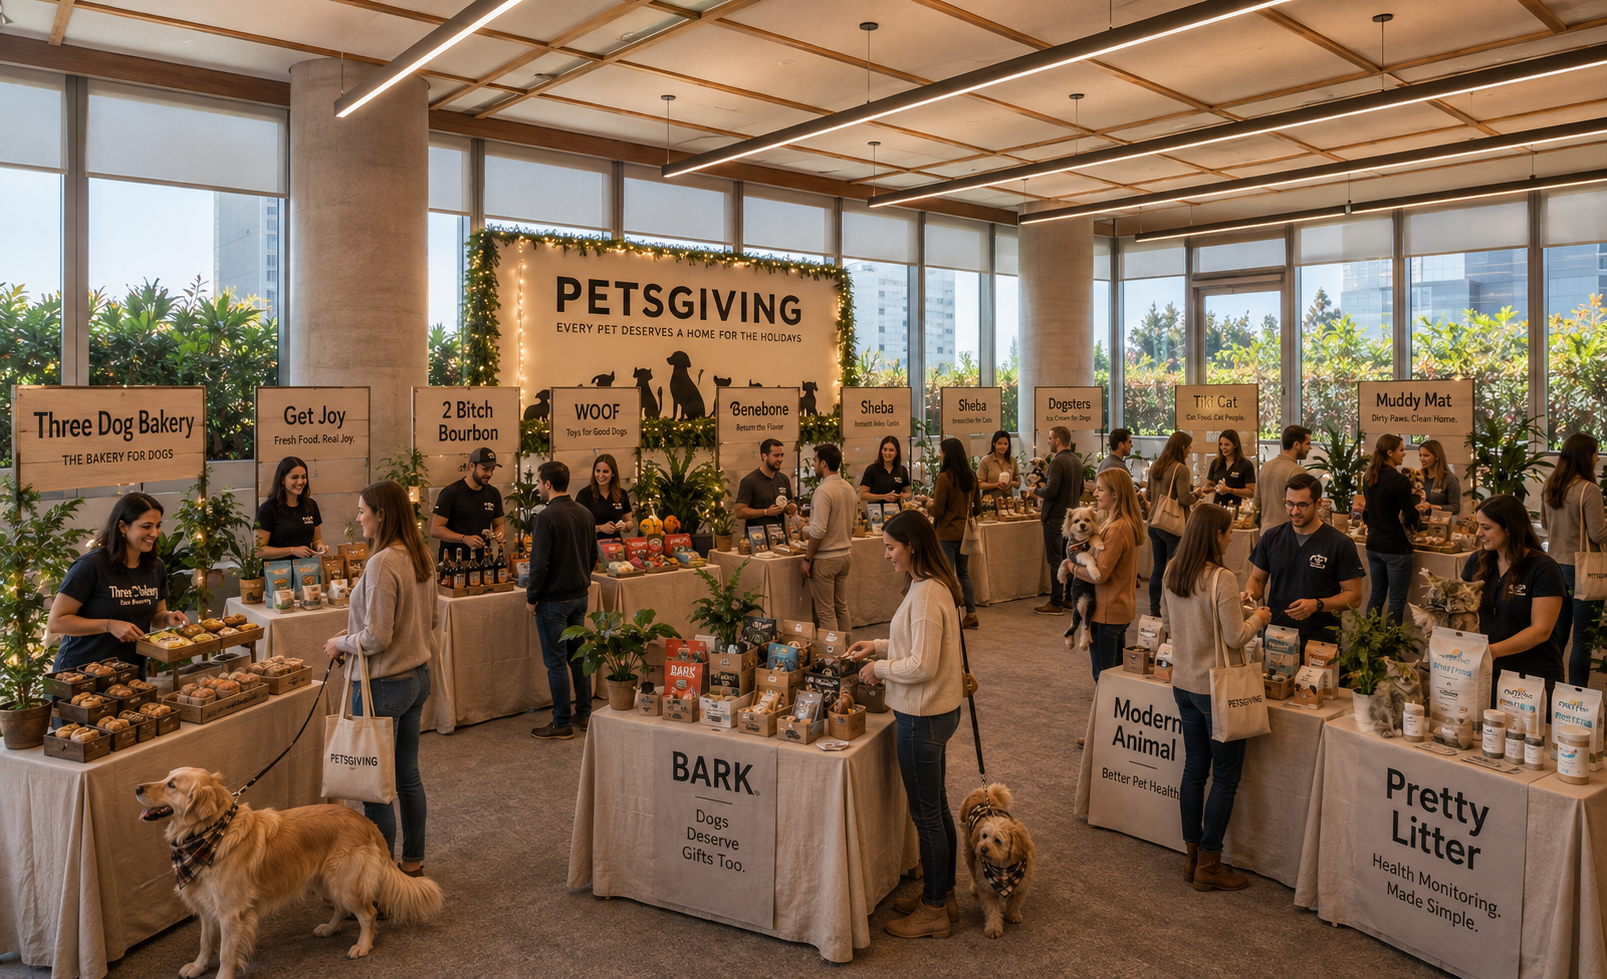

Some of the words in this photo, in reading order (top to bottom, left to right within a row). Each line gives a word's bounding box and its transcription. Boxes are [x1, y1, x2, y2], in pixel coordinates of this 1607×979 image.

[556, 276, 802, 325] PETSGIVING
[556, 322, 594, 334] EVERY
[597, 324, 618, 335] PET
[621, 325, 674, 337] DESERVES
[676, 328, 684, 338] A
[687, 329, 715, 339] HOME
[719, 330, 738, 340] FOR
[740, 331, 758, 341] THE
[760, 332, 802, 343] HOLIDAYS
[442, 400, 452, 418] 2
[457, 400, 493, 418] Bitch
[574, 403, 620, 420] WOOF
[730, 401, 789, 416] Benebone
[861, 400, 894, 414] Sheba
[959, 398, 987, 412] Sheba
[1049, 397, 1091, 413] Dogsters
[1193, 395, 1213, 408] Tiki
[1217, 395, 1238, 408] Cat
[1376, 392, 1421, 411] Muddy
[1425, 392, 1452, 407] Mat
[33, 411, 92, 439] Three
[98, 410, 134, 442] Dog
[139, 409, 195, 438] Bakery
[284, 405, 314, 425] Get
[318, 405, 346, 429] Joy
[1371, 414, 1388, 424] Dirty
[1411, 414, 1431, 422] Clean
[1433, 415, 1458, 423] Home.
[274, 435, 297, 445] Fresh
[299, 434, 320, 444] Food.
[323, 434, 339, 443] Real
[341, 434, 355, 445] Joy.
[439, 424, 498, 442] Bourbon
[566, 428, 581, 438] Toys
[583, 428, 591, 436] for
[593, 427, 610, 436] Good
[612, 427, 627, 437] Dogs
[62, 454, 83, 466] THE
[86, 452, 124, 464] BAKERY
[127, 451, 145, 461] FOR
[149, 449, 174, 460] DOGS
[1114, 697, 1182, 734] Modern
[1112, 725, 1176, 761] Animal
[331, 753, 378, 766] PETSGIVING
[1102, 767, 1130, 785] Better
[1133, 776, 1147, 789] Pet
[1387, 767, 1489, 837] Pretty
[696, 809, 728, 830] Dogs
[687, 827, 739, 850] Deserve
[1393, 810, 1481, 870] Litter
[682, 846, 713, 865] Gifts
[718, 853, 746, 873] Too.
[1373, 853, 1414, 882] Health
[1419, 871, 1501, 918] Monitoring.
[1387, 881, 1423, 909] Made
[1427, 898, 1478, 932] Simple.
